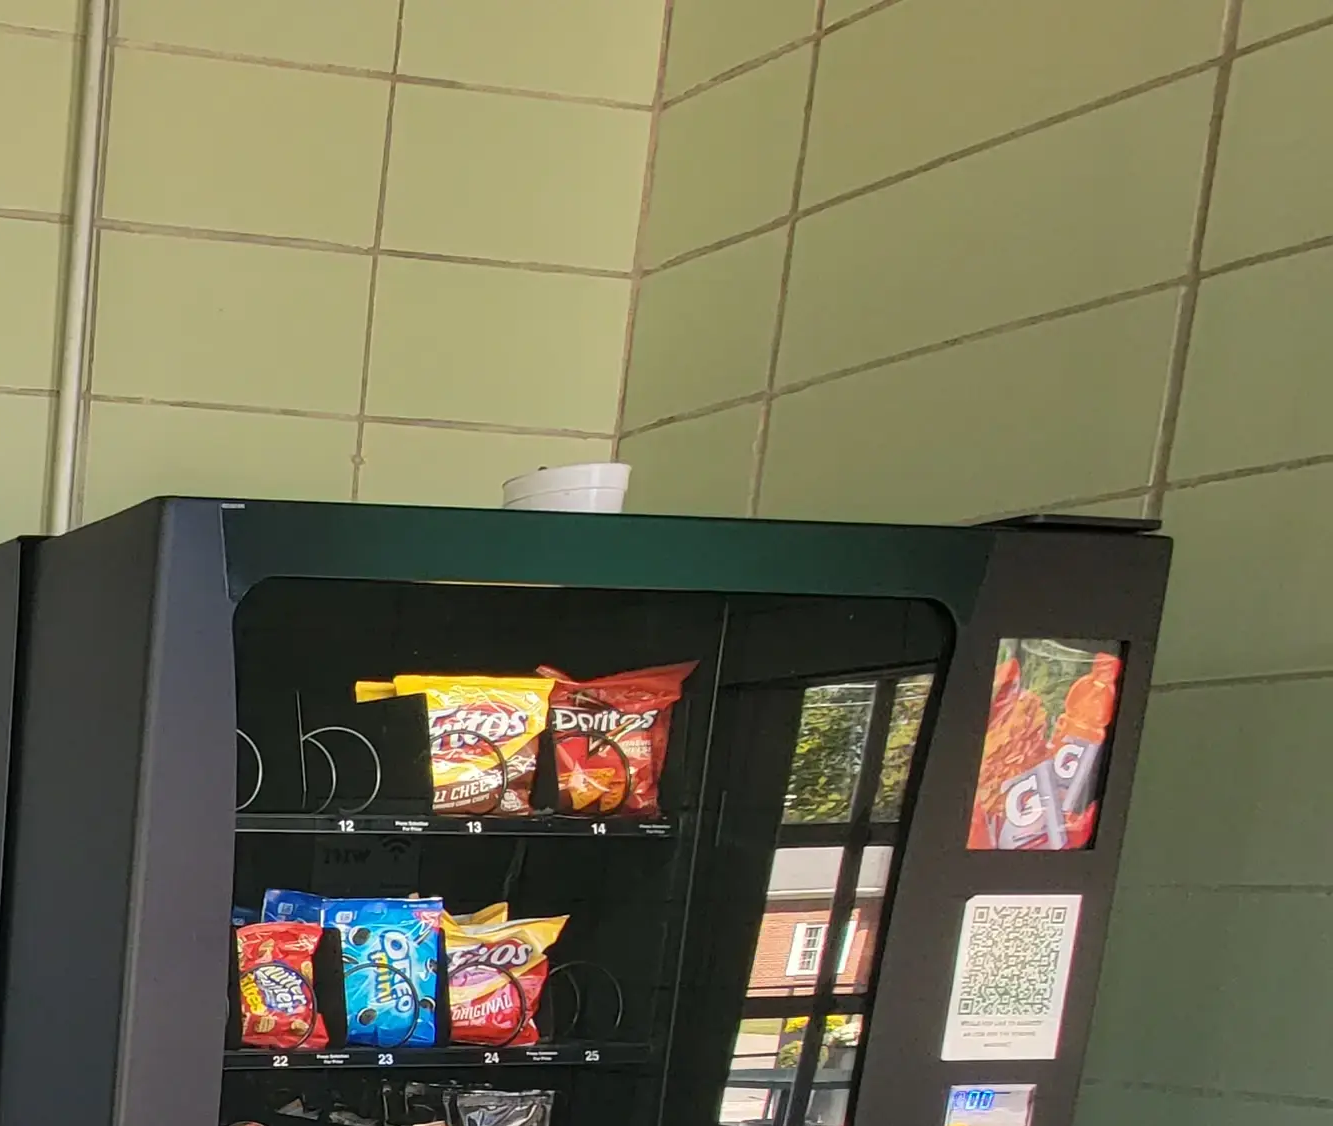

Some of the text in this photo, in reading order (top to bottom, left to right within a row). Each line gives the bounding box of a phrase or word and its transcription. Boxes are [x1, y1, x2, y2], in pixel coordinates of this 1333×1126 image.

[553, 709, 659, 732] Doritos
[1054, 744, 1084, 778] G
[1006, 775, 1043, 826] G
[338, 820, 354, 832] 12
[466, 821, 482, 833] 13
[591, 823, 606, 835] 14
[382, 931, 415, 1012] OREO
[452, 994, 513, 1020] ORIGINAL
[273, 1055, 288, 1067] 22
[378, 1053, 393, 1065] 23
[484, 1053, 499, 1064] 24
[585, 1051, 600, 1061] 25
